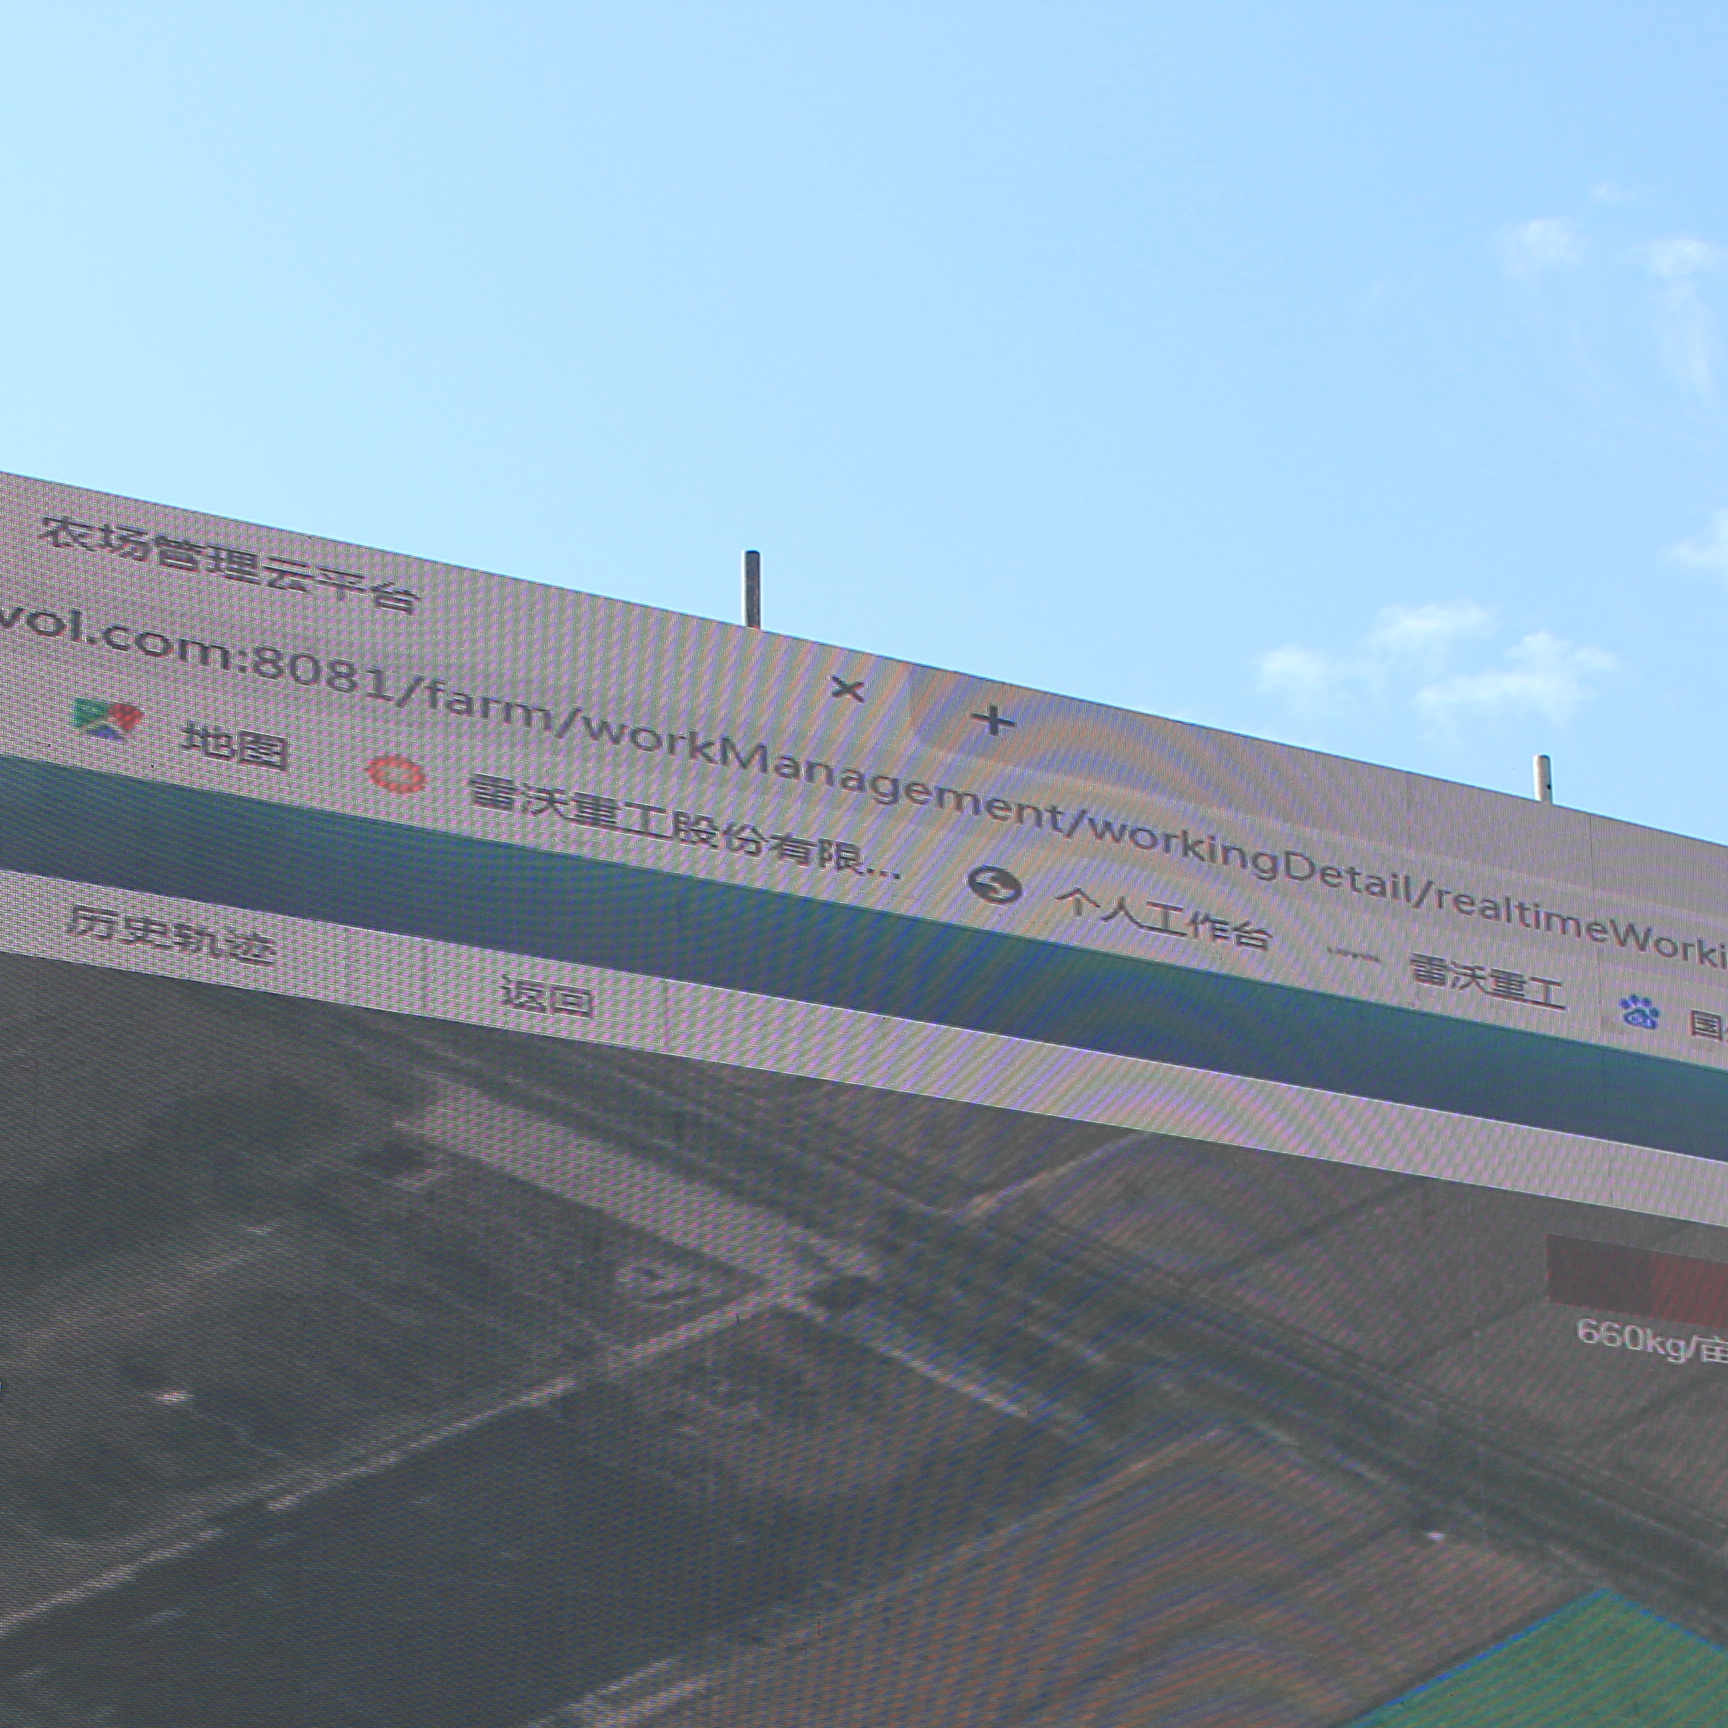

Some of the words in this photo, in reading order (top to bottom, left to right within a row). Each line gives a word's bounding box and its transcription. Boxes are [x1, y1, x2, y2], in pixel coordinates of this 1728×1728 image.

[39, 514, 425, 617] 农场管理云平台
[181, 721, 290, 771] 地图
[66, 904, 276, 968] 历史轨迹
[1055, 888, 1273, 954] 个人工作台
[500, 973, 595, 1020] 返回
[1410, 953, 1567, 1010] 雷沃重工
